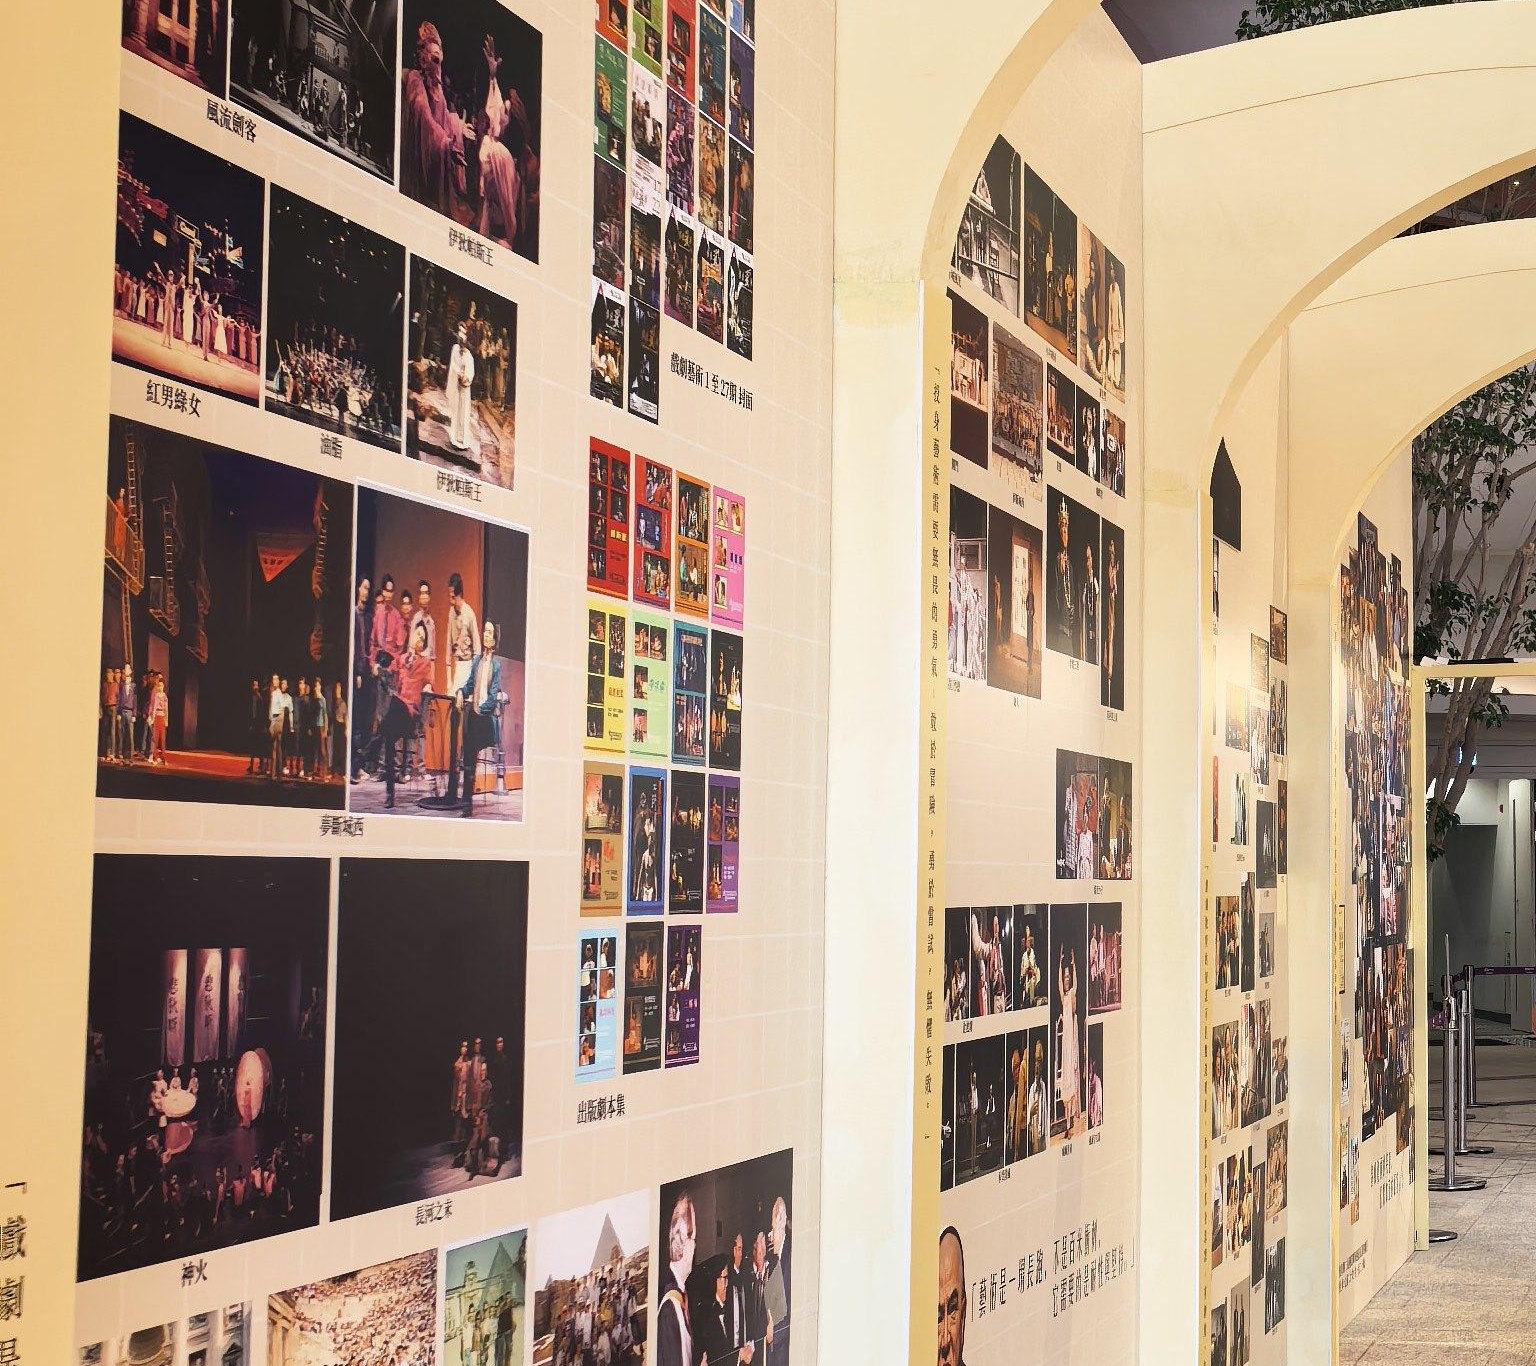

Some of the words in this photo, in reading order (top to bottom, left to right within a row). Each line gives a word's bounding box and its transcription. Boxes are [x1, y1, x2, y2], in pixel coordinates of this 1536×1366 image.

[146, 380, 203, 419] 紅男綠女
[577, 1094, 626, 1126] 出版劇本集
